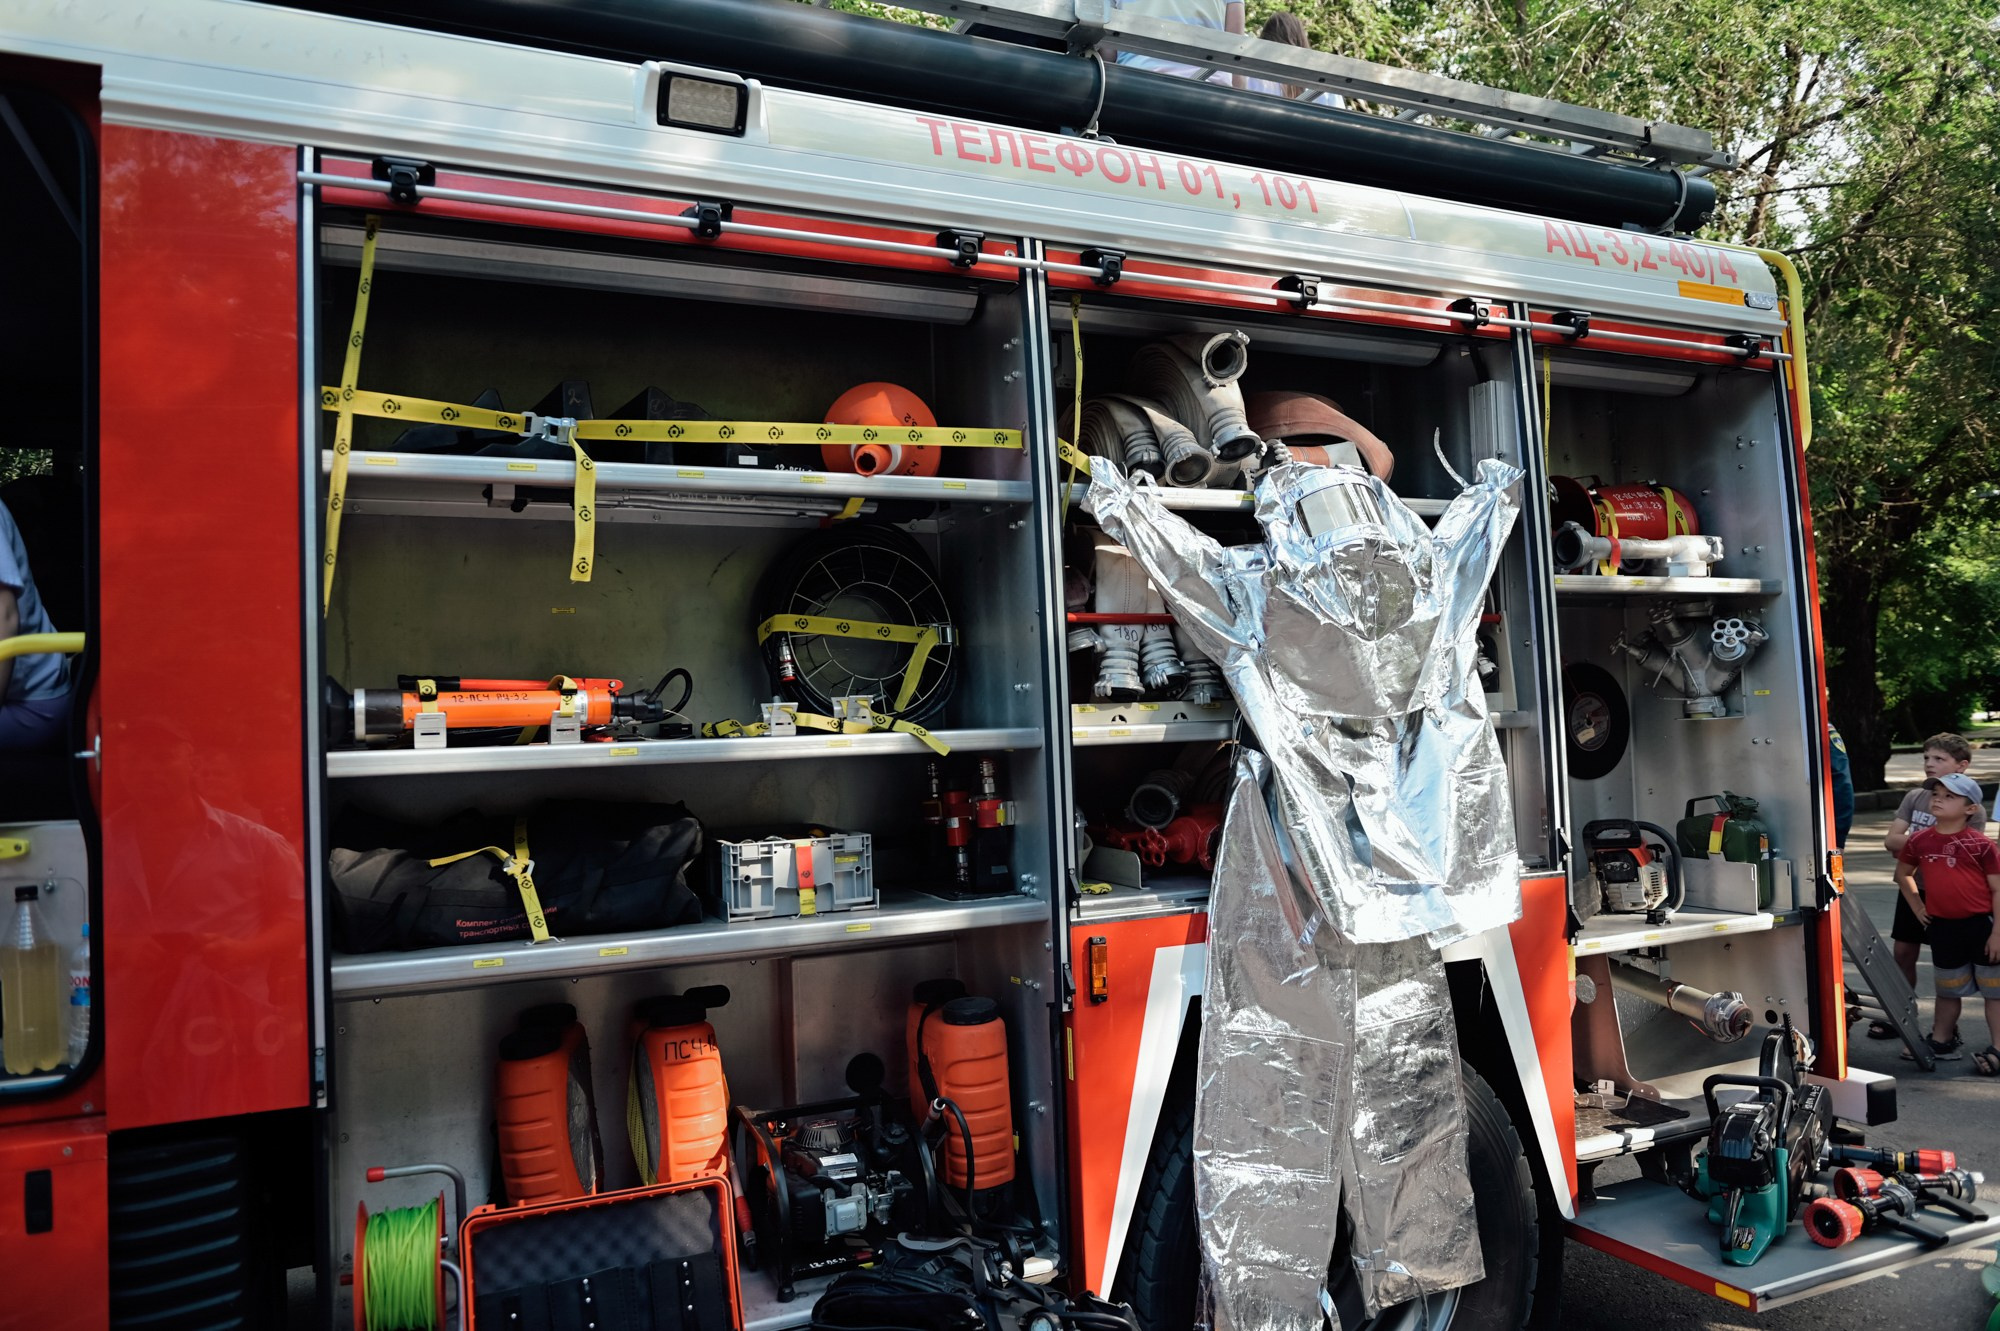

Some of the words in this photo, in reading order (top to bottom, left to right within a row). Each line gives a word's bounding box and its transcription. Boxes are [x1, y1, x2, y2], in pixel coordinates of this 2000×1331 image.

[916, 117, 1167, 191] ТЕЛЕФОН
[1177, 160, 1241, 209] 01,
[1251, 172, 1319, 214] 101
[1543, 221, 1738, 285] АЦ-3,2-40/4
[456, 919, 498, 928] Комплект
